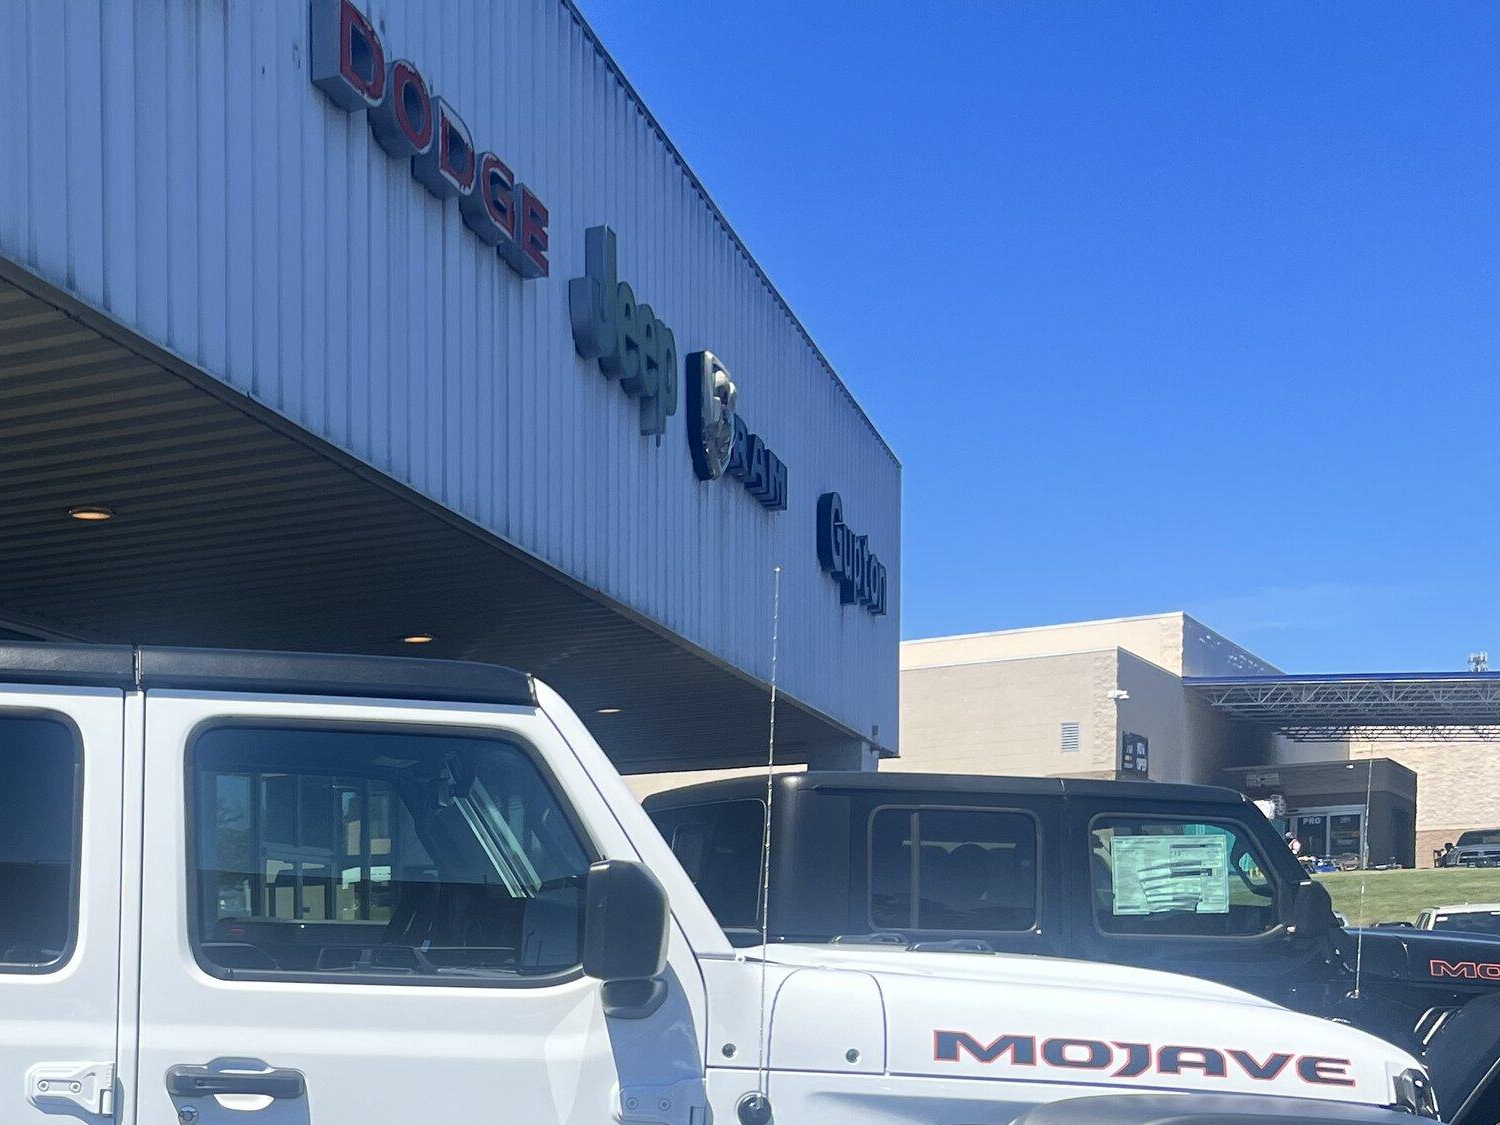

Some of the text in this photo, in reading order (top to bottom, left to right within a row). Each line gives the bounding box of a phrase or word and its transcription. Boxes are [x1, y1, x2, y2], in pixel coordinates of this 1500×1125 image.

[312, 0, 549, 279] DODGE
[569, 224, 678, 436] Jeep
[729, 413, 788, 511] RAM
[816, 492, 887, 615] Gupton
[1302, 817, 1321, 826] PRO
[933, 1029, 1357, 1088] MOJAVE
